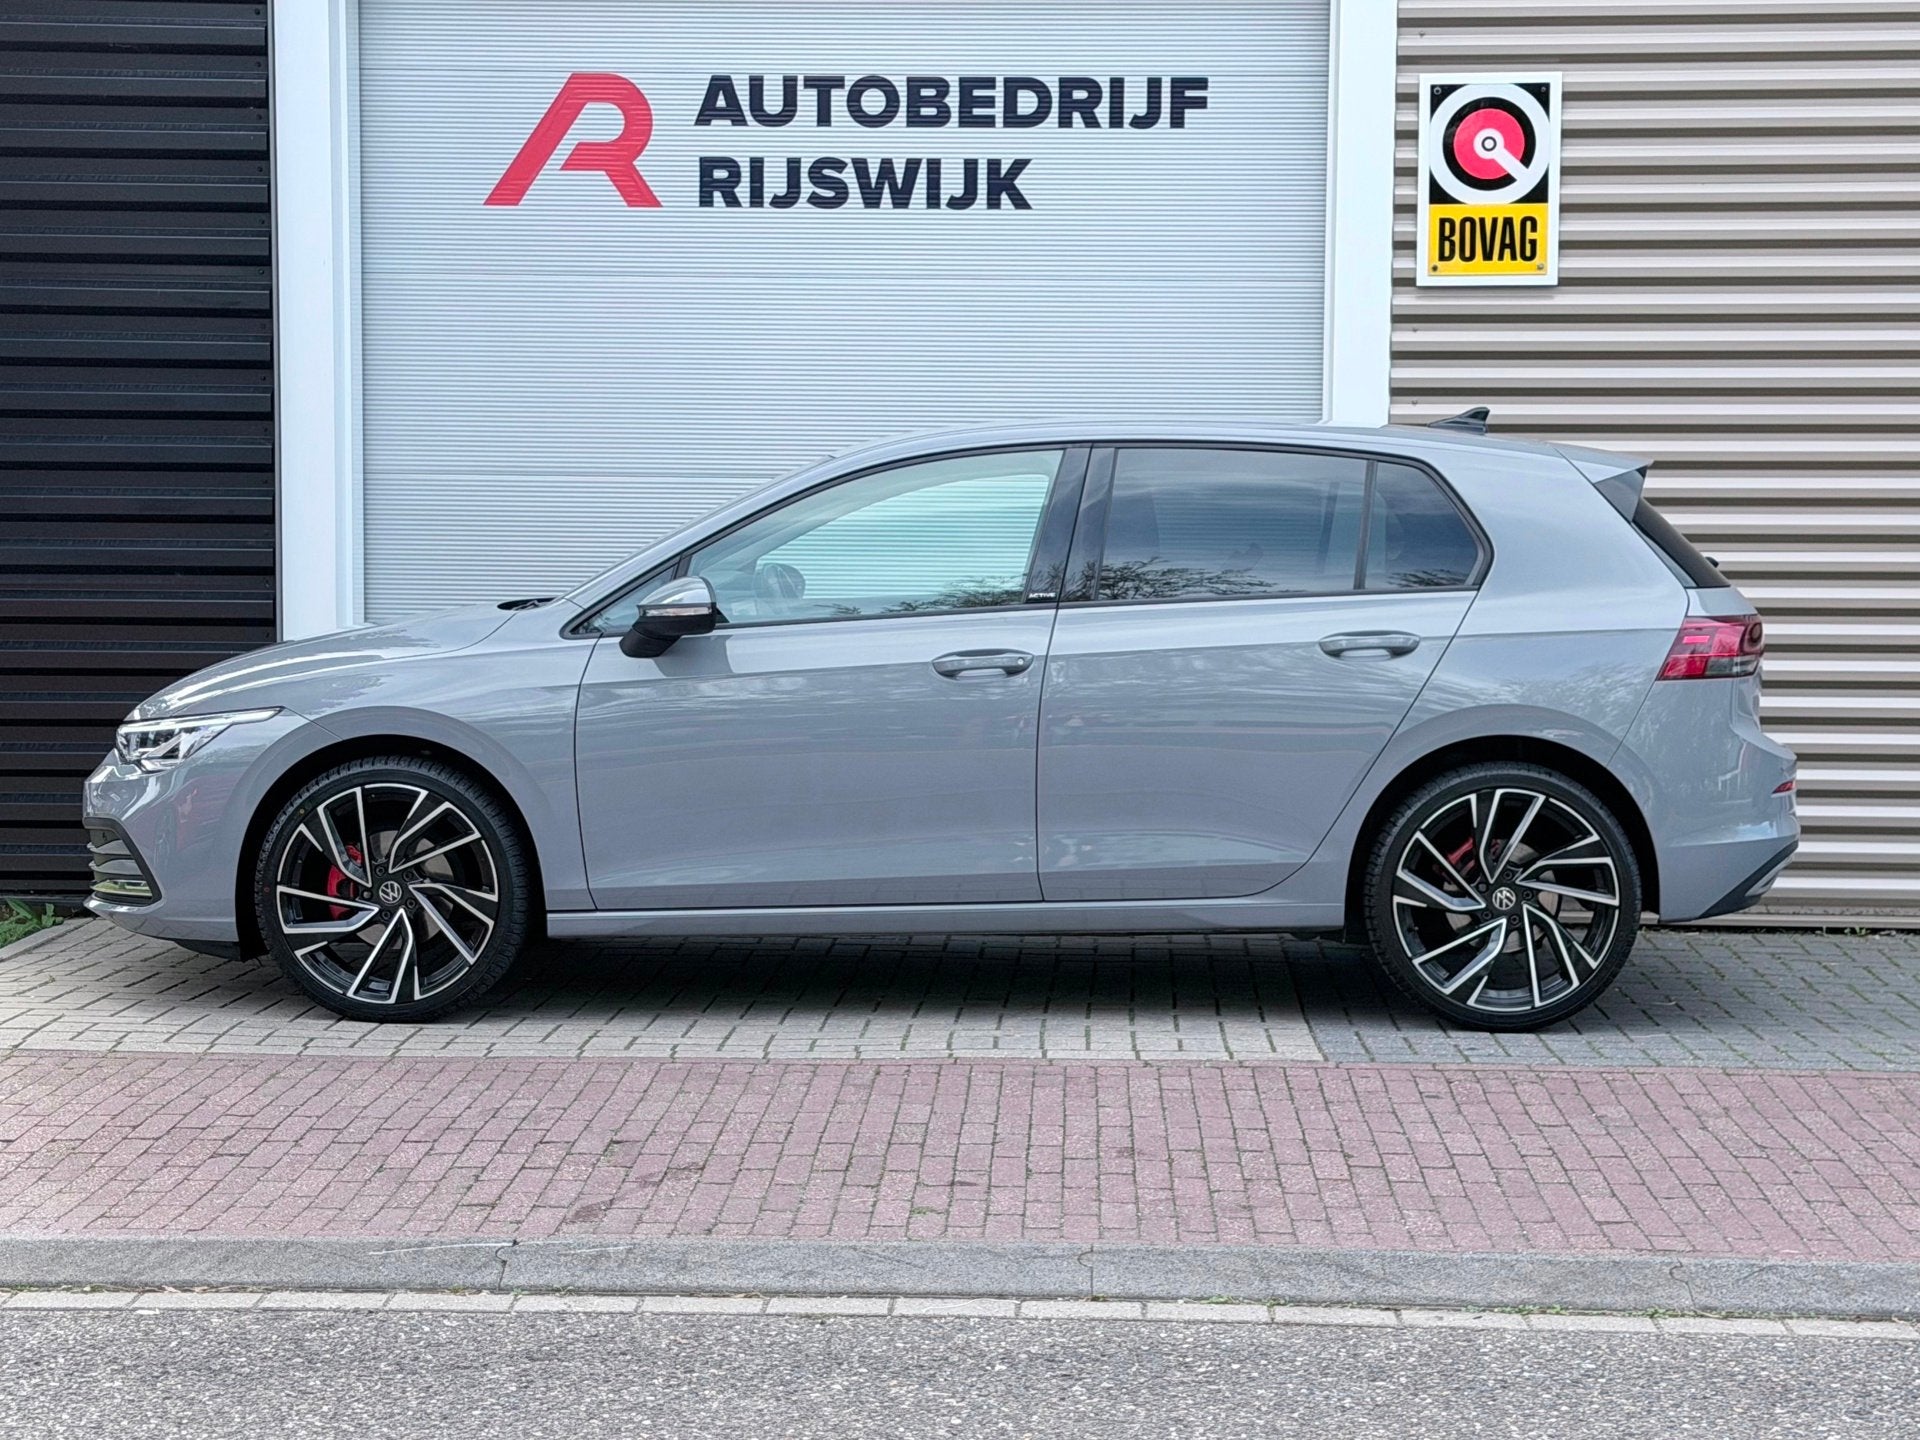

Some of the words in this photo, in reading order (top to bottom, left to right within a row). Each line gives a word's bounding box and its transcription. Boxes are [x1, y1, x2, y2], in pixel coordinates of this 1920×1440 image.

[694, 75, 1209, 130] AUTOBEDRIJF
[699, 156, 1033, 210] RIJSWIJK
[1438, 215, 1538, 263] BOVAG
